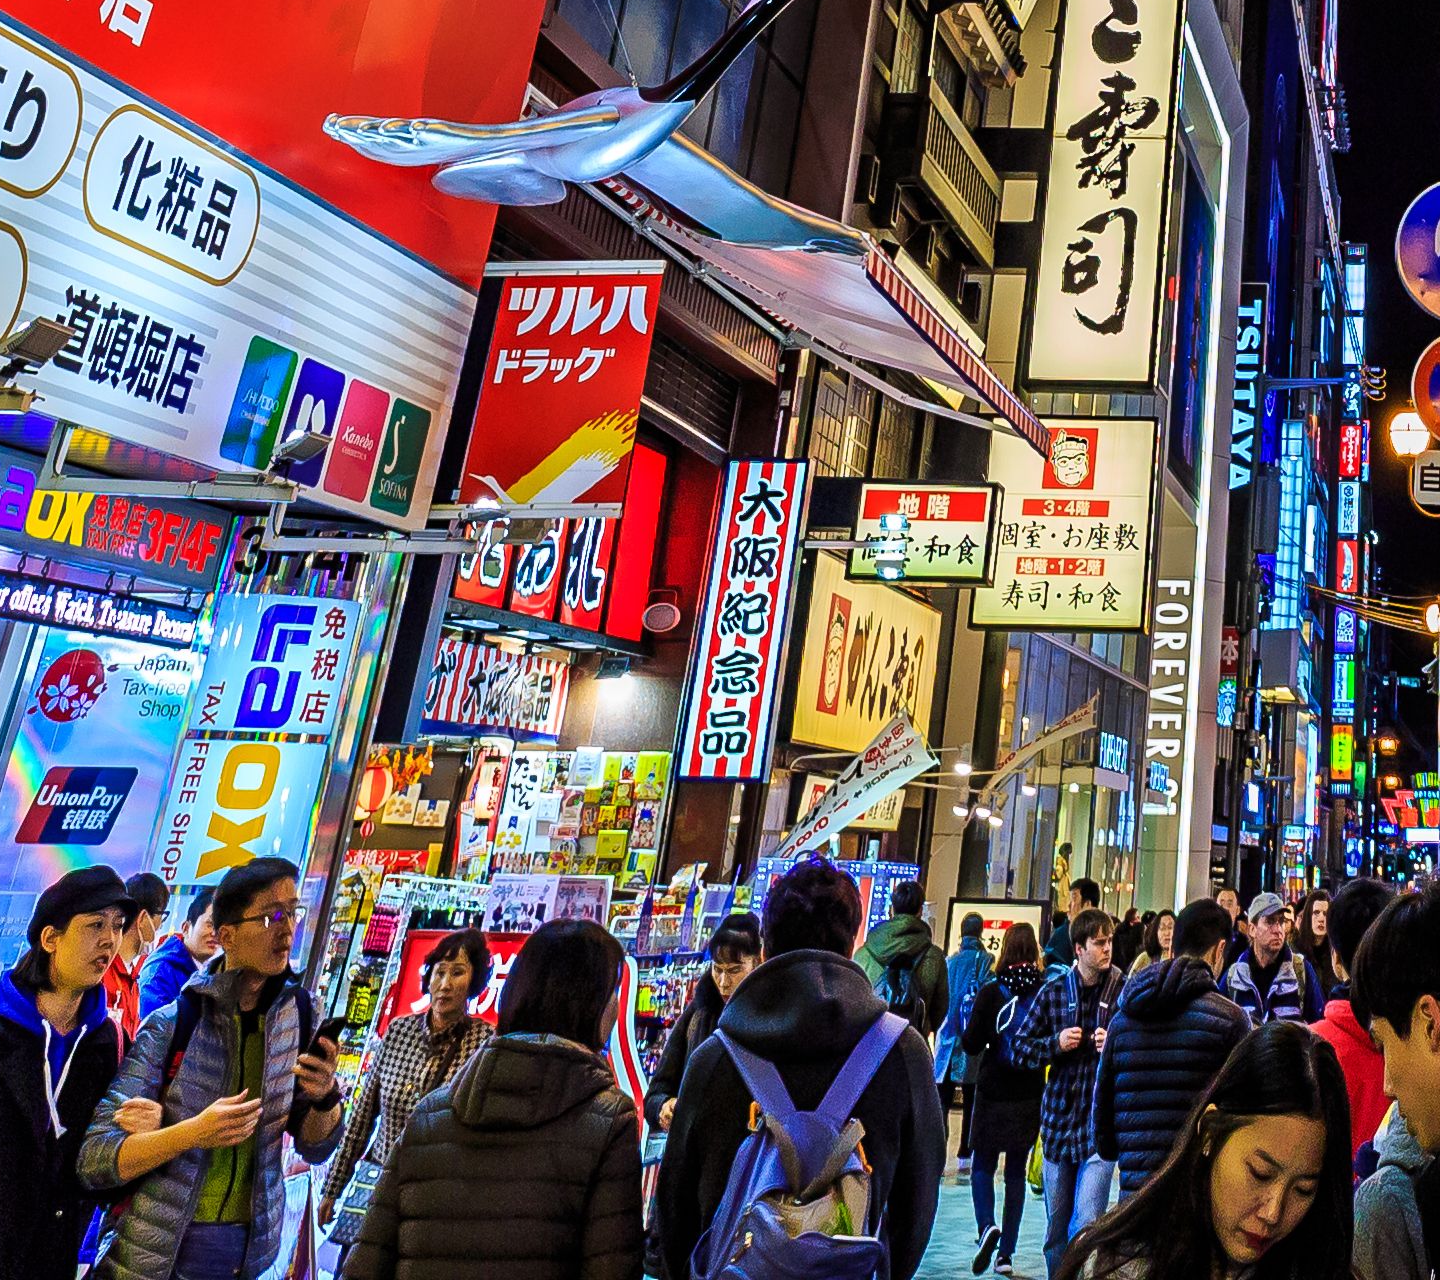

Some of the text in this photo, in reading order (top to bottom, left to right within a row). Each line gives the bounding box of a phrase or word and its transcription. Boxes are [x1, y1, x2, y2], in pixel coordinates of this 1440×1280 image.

[113, 138, 239, 262] 化粧品
[507, 283, 651, 336] ツルハ
[52, 285, 206, 414] 道頓堀店
[493, 347, 615, 383] ドラッグ
[1229, 300, 1262, 490] TSUTAYA
[91, 493, 143, 539] 免税店
[378, 478, 408, 501] SOFINA
[898, 493, 951, 520] 地階
[141, 515, 222, 576] 3F/4F
[699, 478, 788, 758] 大阪紀念品
[121, 677, 186, 701] Tax-free
[133, 654, 191, 674] Japan.
[298, 606, 348, 726] 免税店
[1145, 579, 1190, 763] FOREVER
[138, 699, 181, 721] Shop
[37, 784, 122, 810] UnionPay
[162, 681, 226, 884] TAX FREE SHOP
